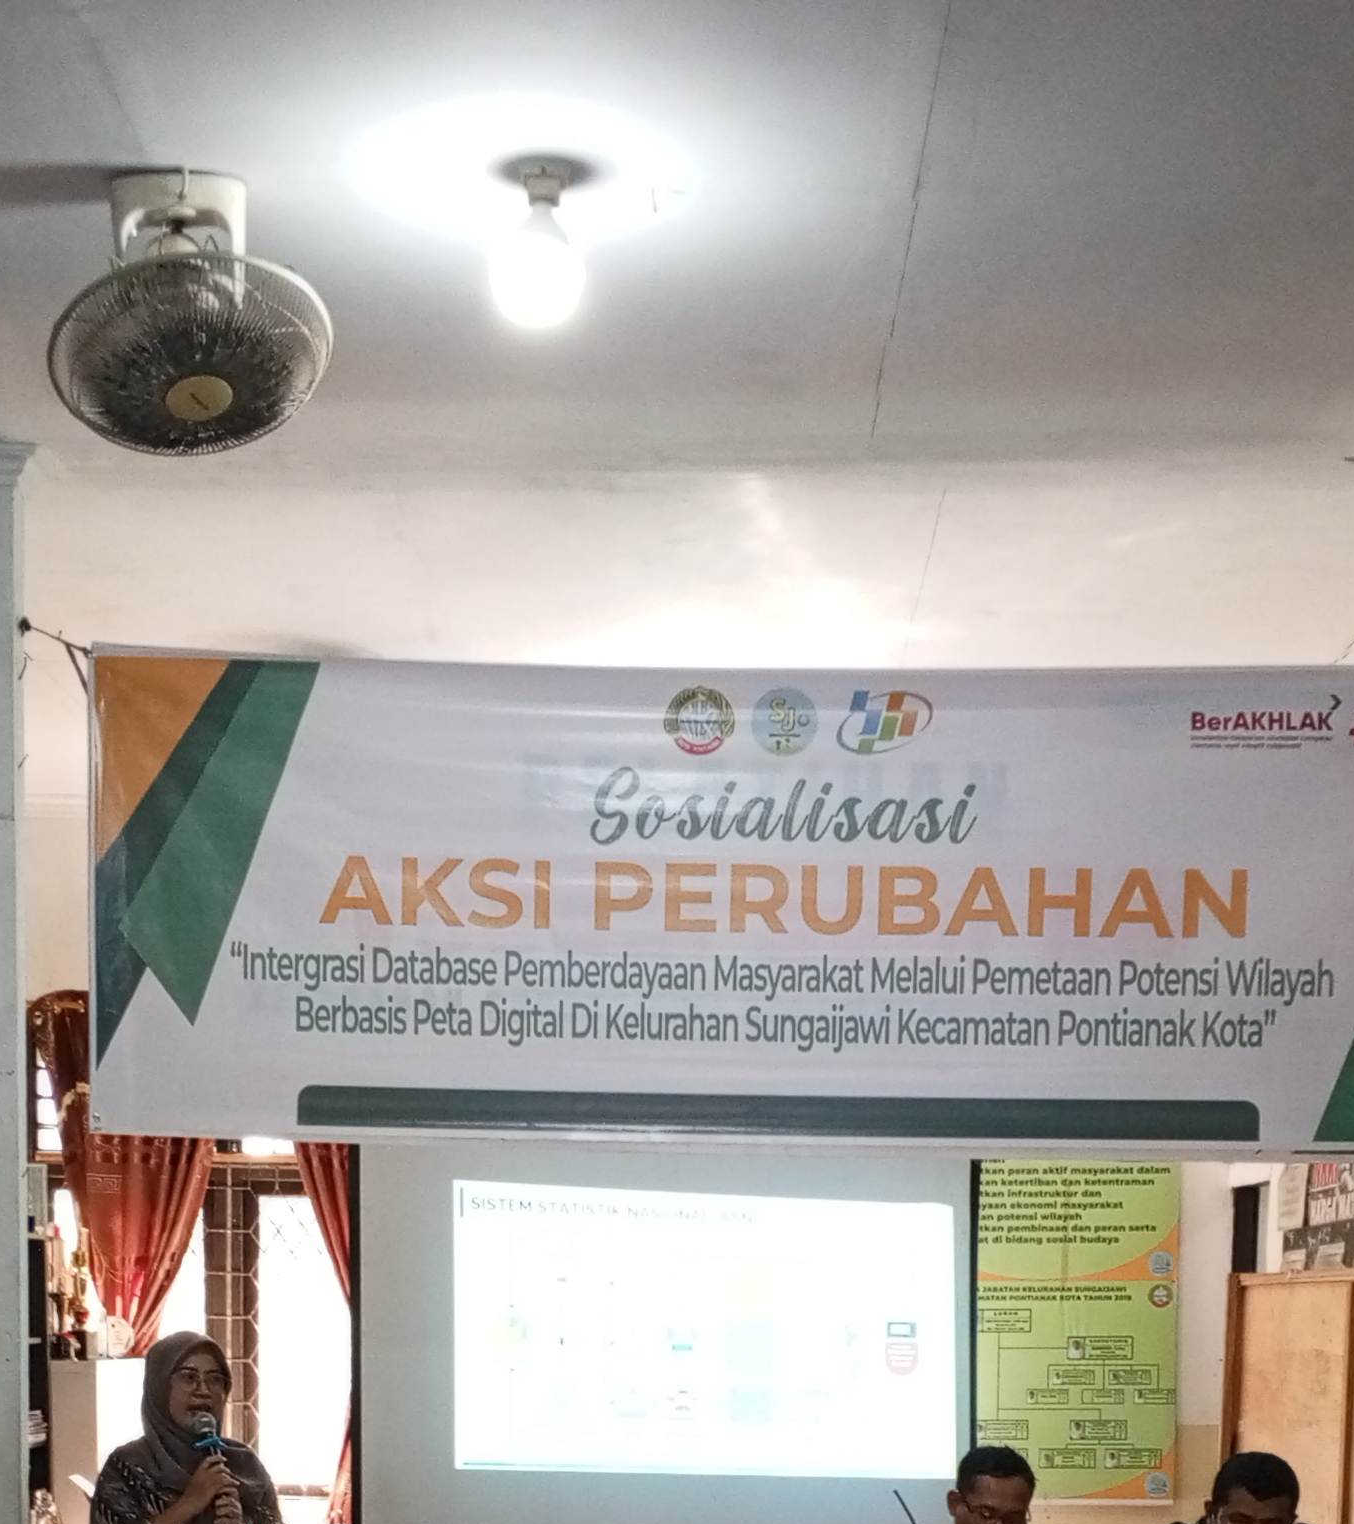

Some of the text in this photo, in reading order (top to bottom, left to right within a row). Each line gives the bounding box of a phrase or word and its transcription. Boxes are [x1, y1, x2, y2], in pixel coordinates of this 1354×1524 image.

[1190, 710, 1333, 732] BerAKHLAK
[590, 766, 978, 846] Sosialisasi
[318, 854, 1250, 939] AKSI PERUBAHAN
[372, 947, 498, 985] Database
[504, 950, 706, 998] Pemberdayaan
[714, 953, 864, 1001] Masyarakat
[871, 955, 966, 995] Melalui
[972, 958, 1112, 997] Pemetaan
[1119, 958, 1220, 998] Potensi
[1224, 959, 1335, 1006] Wilayah
[295, 996, 407, 1035] Berbasis
[414, 998, 473, 1036] Peta
[479, 998, 564, 1047] Digital
[571, 1002, 599, 1039] Di
[605, 1002, 738, 1042] Kelurahan
[745, 1004, 890, 1053] Sungaijawi
[897, 1007, 1051, 1046] Kecamatan
[1057, 1009, 1195, 1048] Pontianak
[1042, 1166, 1068, 1175] aktif
[1070, 1166, 1134, 1176] masyarakat
[1136, 1165, 1171, 1174] dalam
[1061, 1178, 1082, 1186] dan
[1084, 1178, 1155, 1187] ketentraman
[1007, 1189, 1078, 1198] infrastruktur
[1081, 1190, 1102, 1198] dan
[470, 1197, 532, 1212] SISTEM
[1060, 1201, 1123, 1211] masyarakat
[997, 1212, 1037, 1222] potensi
[1040, 1212, 1082, 1223] wilayah
[1007, 1224, 1068, 1233] pembinaan
[1071, 1224, 1092, 1232] dan
[992, 1236, 1002, 1244] di
[1005, 1236, 1043, 1245] bidang
[1046, 1235, 1077, 1244] sosial
[1080, 1236, 1119, 1246] budaya
